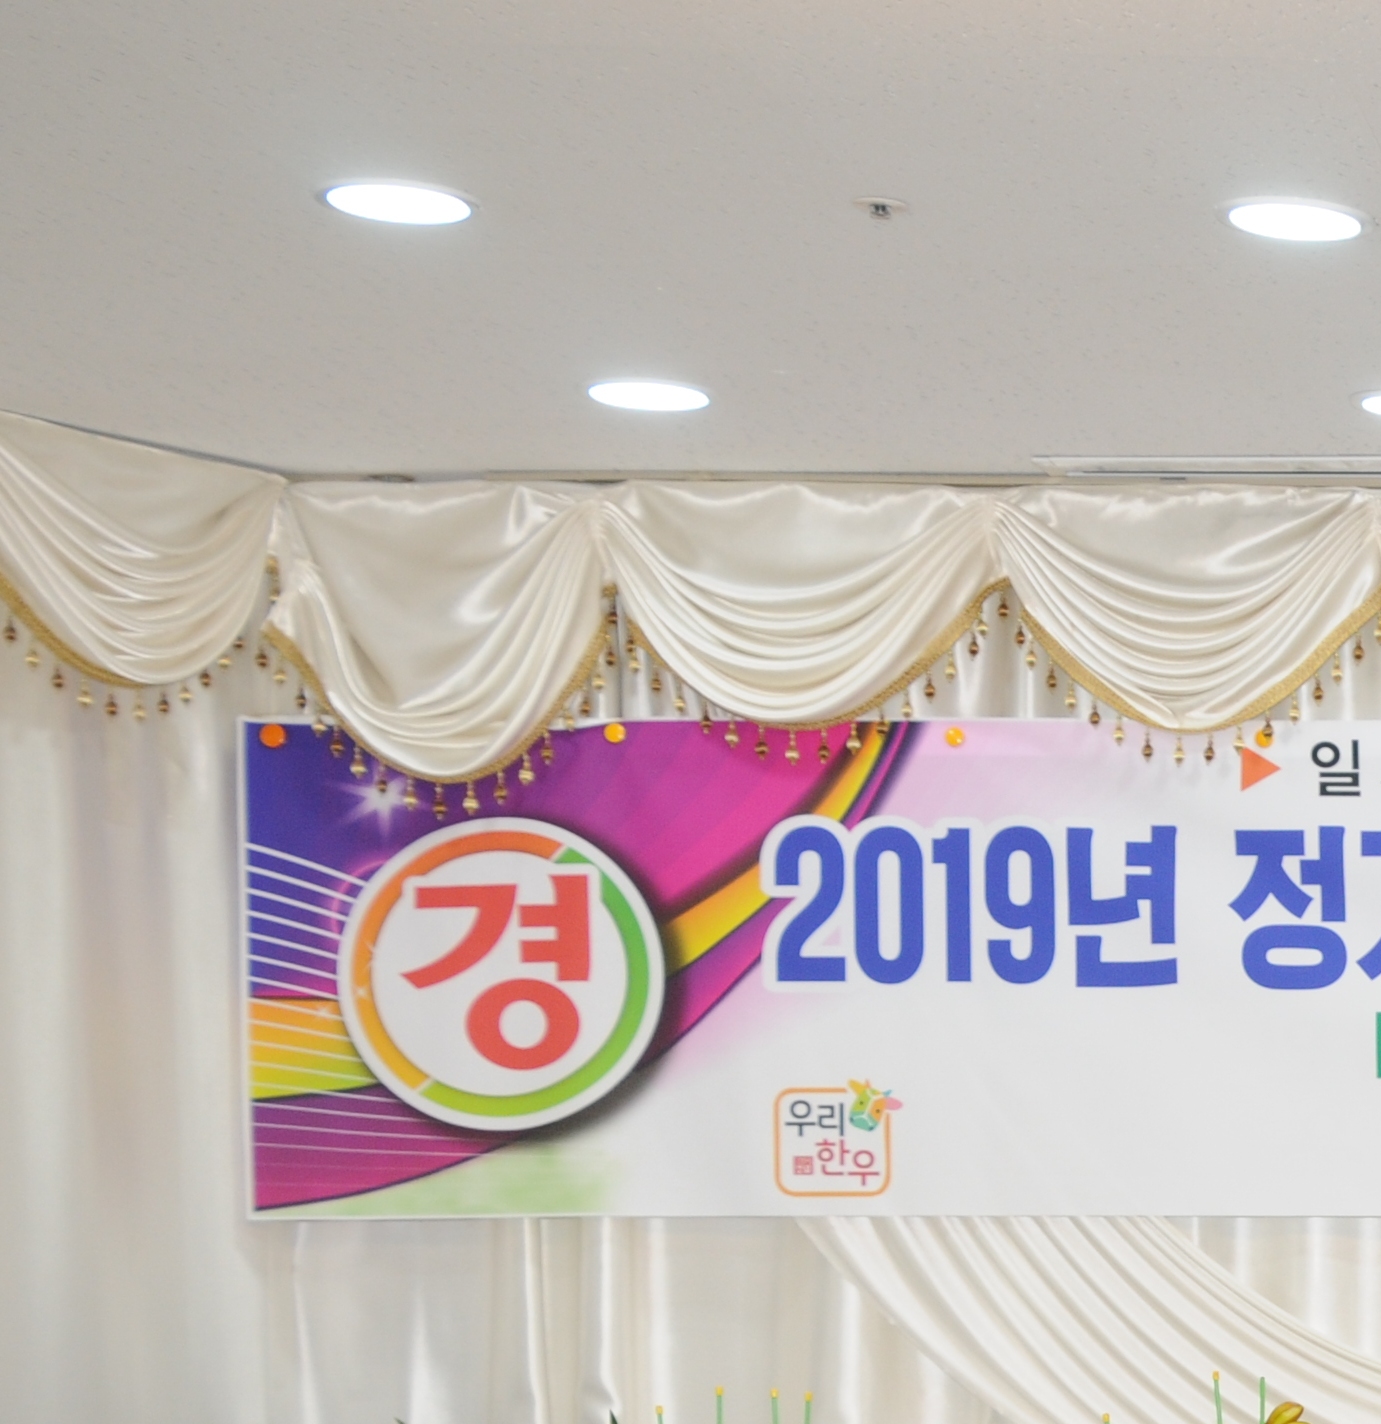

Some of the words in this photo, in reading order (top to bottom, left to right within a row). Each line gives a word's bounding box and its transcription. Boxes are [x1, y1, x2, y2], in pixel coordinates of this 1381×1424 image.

[1311, 740, 1362, 798] 일
[775, 824, 1179, 989] 2019년
[401, 873, 592, 1071] 경
[785, 1100, 845, 1137] 우리
[816, 1139, 880, 1186] 한우
